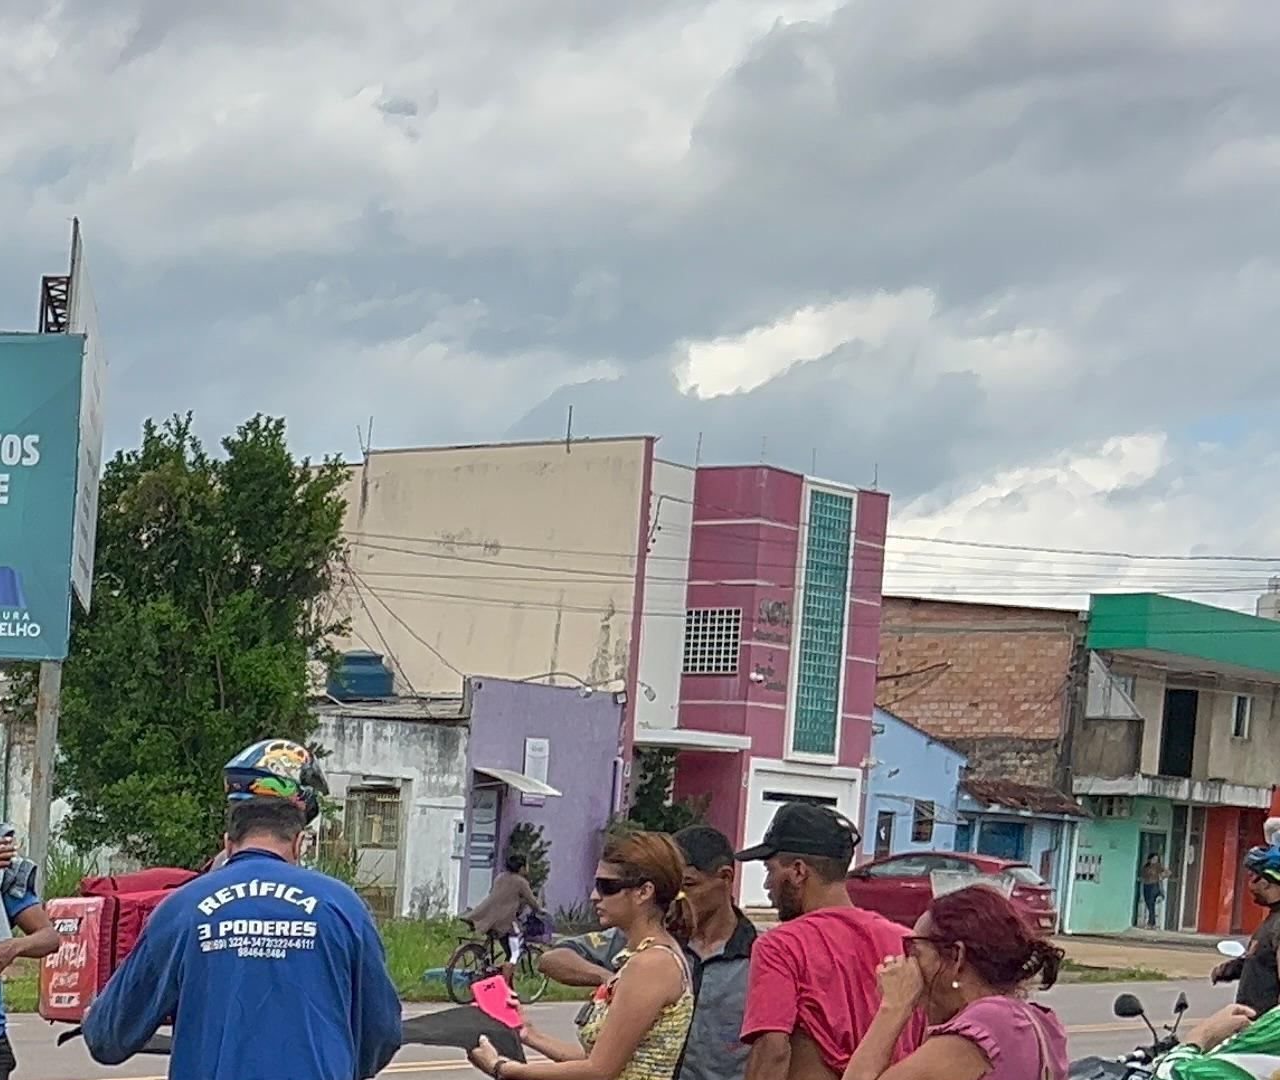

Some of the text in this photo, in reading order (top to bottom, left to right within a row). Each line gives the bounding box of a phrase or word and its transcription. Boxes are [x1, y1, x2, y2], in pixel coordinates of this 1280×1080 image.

[197, 879, 318, 917] RETÍFICA
[197, 919, 317, 941] 3 PODERES
